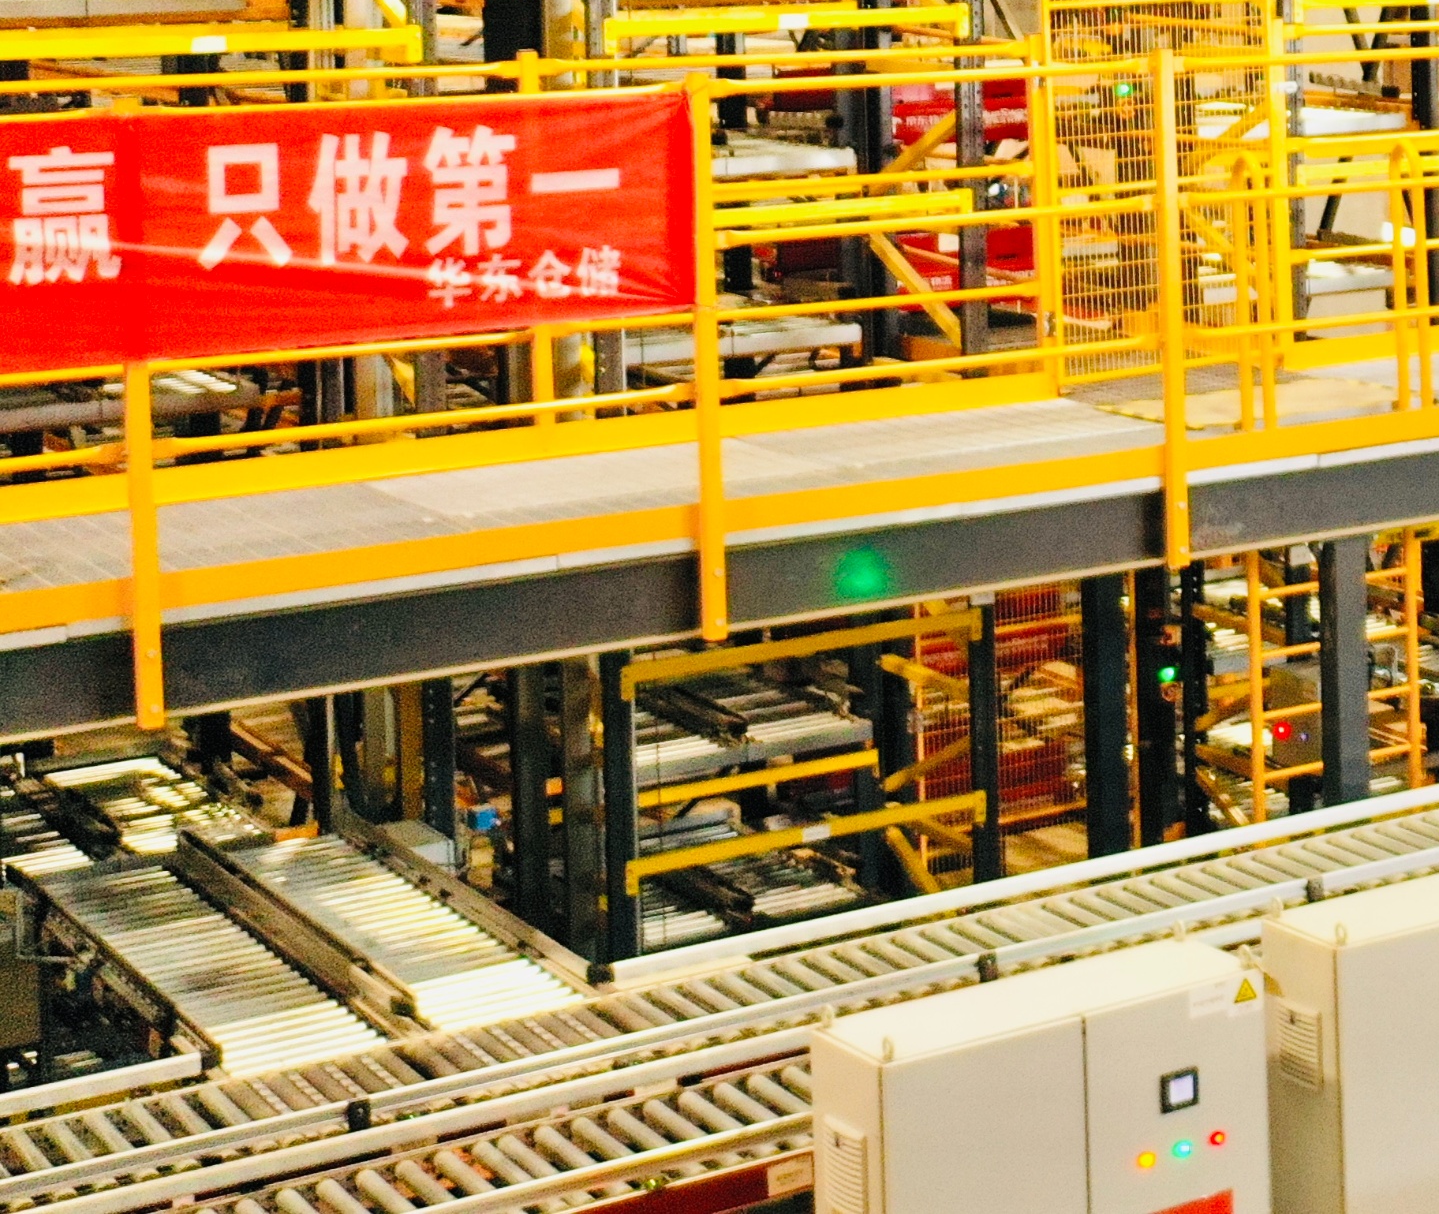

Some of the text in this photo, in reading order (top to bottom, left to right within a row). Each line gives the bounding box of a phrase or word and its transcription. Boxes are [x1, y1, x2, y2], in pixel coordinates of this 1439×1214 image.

[8, 124, 621, 285] 赢 只做第一
[426, 244, 622, 309] 华东仓储
